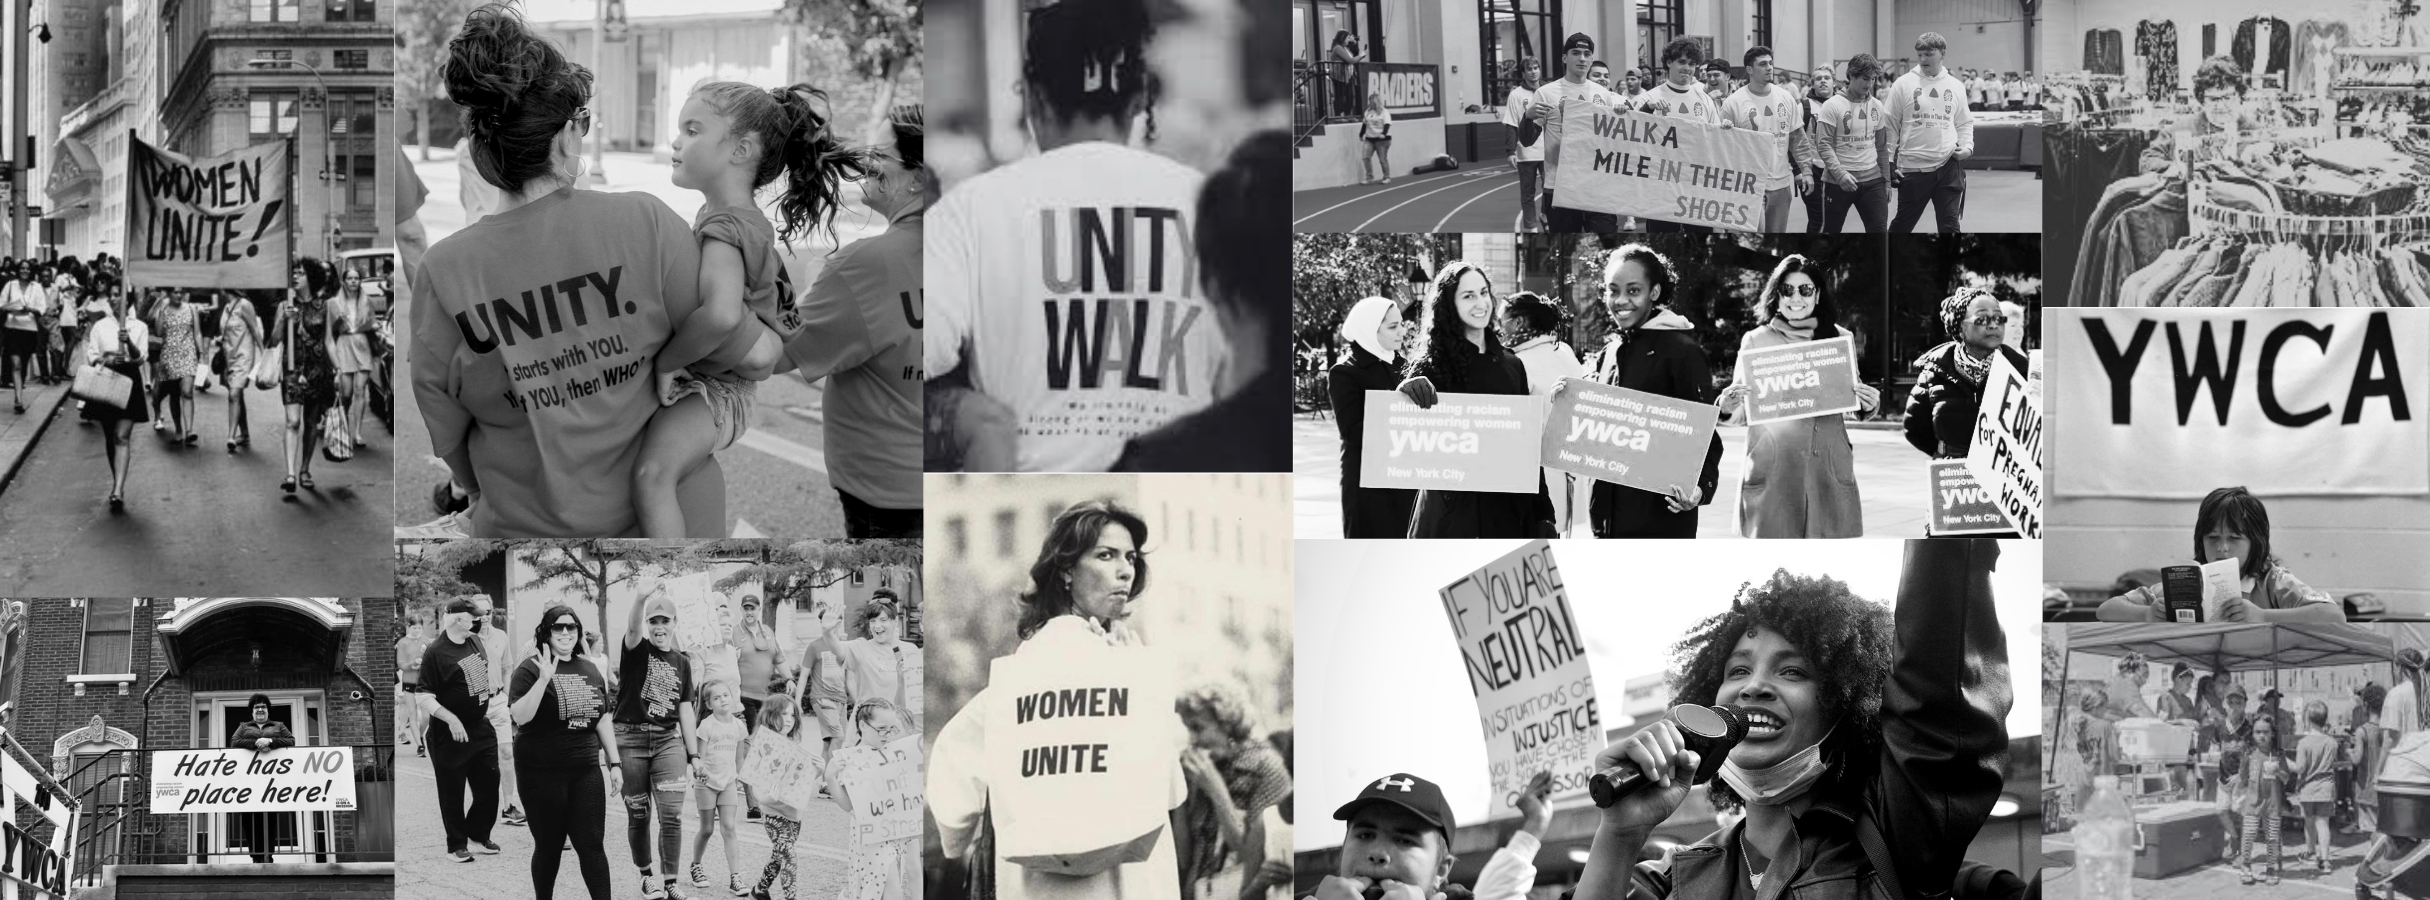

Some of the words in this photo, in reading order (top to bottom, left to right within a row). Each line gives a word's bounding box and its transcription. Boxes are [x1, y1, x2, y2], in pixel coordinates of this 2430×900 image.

[1593, 113, 1658, 145] WALK
[1661, 126, 1678, 149] A
[150, 156, 261, 208] WOMEN
[1593, 148, 1651, 178] MILE
[1658, 158, 1682, 183] IN
[1690, 163, 1757, 195] THEIR
[1674, 195, 1748, 226] SHOES
[146, 199, 283, 262] UNITE!
[1041, 206, 1197, 300] UNITY
[455, 266, 637, 354] UNITY.
[513, 360, 549, 382] starts
[551, 345, 588, 372] with
[586, 334, 629, 360] YOU.
[1044, 299, 1201, 396] WALK
[1752, 352, 1803, 367] eliminating
[1806, 347, 1837, 359] racism
[1753, 361, 1810, 376] empowering
[1812, 355, 1847, 367] women
[2080, 311, 2411, 427] YWCA
[528, 385, 566, 411] YOU,
[566, 378, 602, 401] then
[603, 355, 646, 388] WHO?
[1755, 370, 1820, 399] ywca
[1390, 401, 1462, 415] elimating
[1467, 404, 1511, 415] racism
[1574, 402, 1647, 427] empowering
[1650, 418, 1693, 435] women
[1578, 390, 1643, 413] eliminating
[1646, 404, 1688, 421] racism
[1759, 404, 1777, 413] New
[1778, 400, 1797, 410] York
[1798, 398, 1814, 408] City
[1389, 415, 1470, 429] empowering
[1475, 419, 1521, 430] women
[1566, 415, 1650, 452] ywca
[1389, 430, 1479, 457] ywca
[1387, 467, 1412, 478] New
[1415, 467, 1440, 479] York
[1442, 469, 1465, 482] City
[1559, 449, 1582, 463] New
[1584, 455, 1607, 469] York
[1608, 460, 1630, 476] City
[1939, 467, 1969, 477] elimin
[1939, 477, 1979, 488] empowe
[1941, 486, 1991, 510] ywc
[1943, 516, 1960, 525] New
[1963, 513, 1982, 523] York
[1984, 512, 2001, 524] City
[2000, 483, 2041, 539] WORK
[1442, 577, 1470, 640] IF
[1461, 594, 1585, 697] NEUTRAL
[1571, 675, 1592, 698] OF
[1017, 687, 1128, 725] WOMEN
[173, 752, 238, 777] Hate
[246, 751, 294, 775] has
[302, 751, 344, 774] NO
[1022, 744, 1108, 778] UNITE
[1489, 760, 1510, 778] YOU
[1515, 746, 1544, 770] HAVE
[1546, 728, 1597, 757] CHOSEN
[1561, 747, 1587, 767] THE
[156, 789, 179, 798] ywca
[179, 783, 252, 811] place
[261, 778, 332, 803] here!
[2, 820, 67, 896] YWCA
